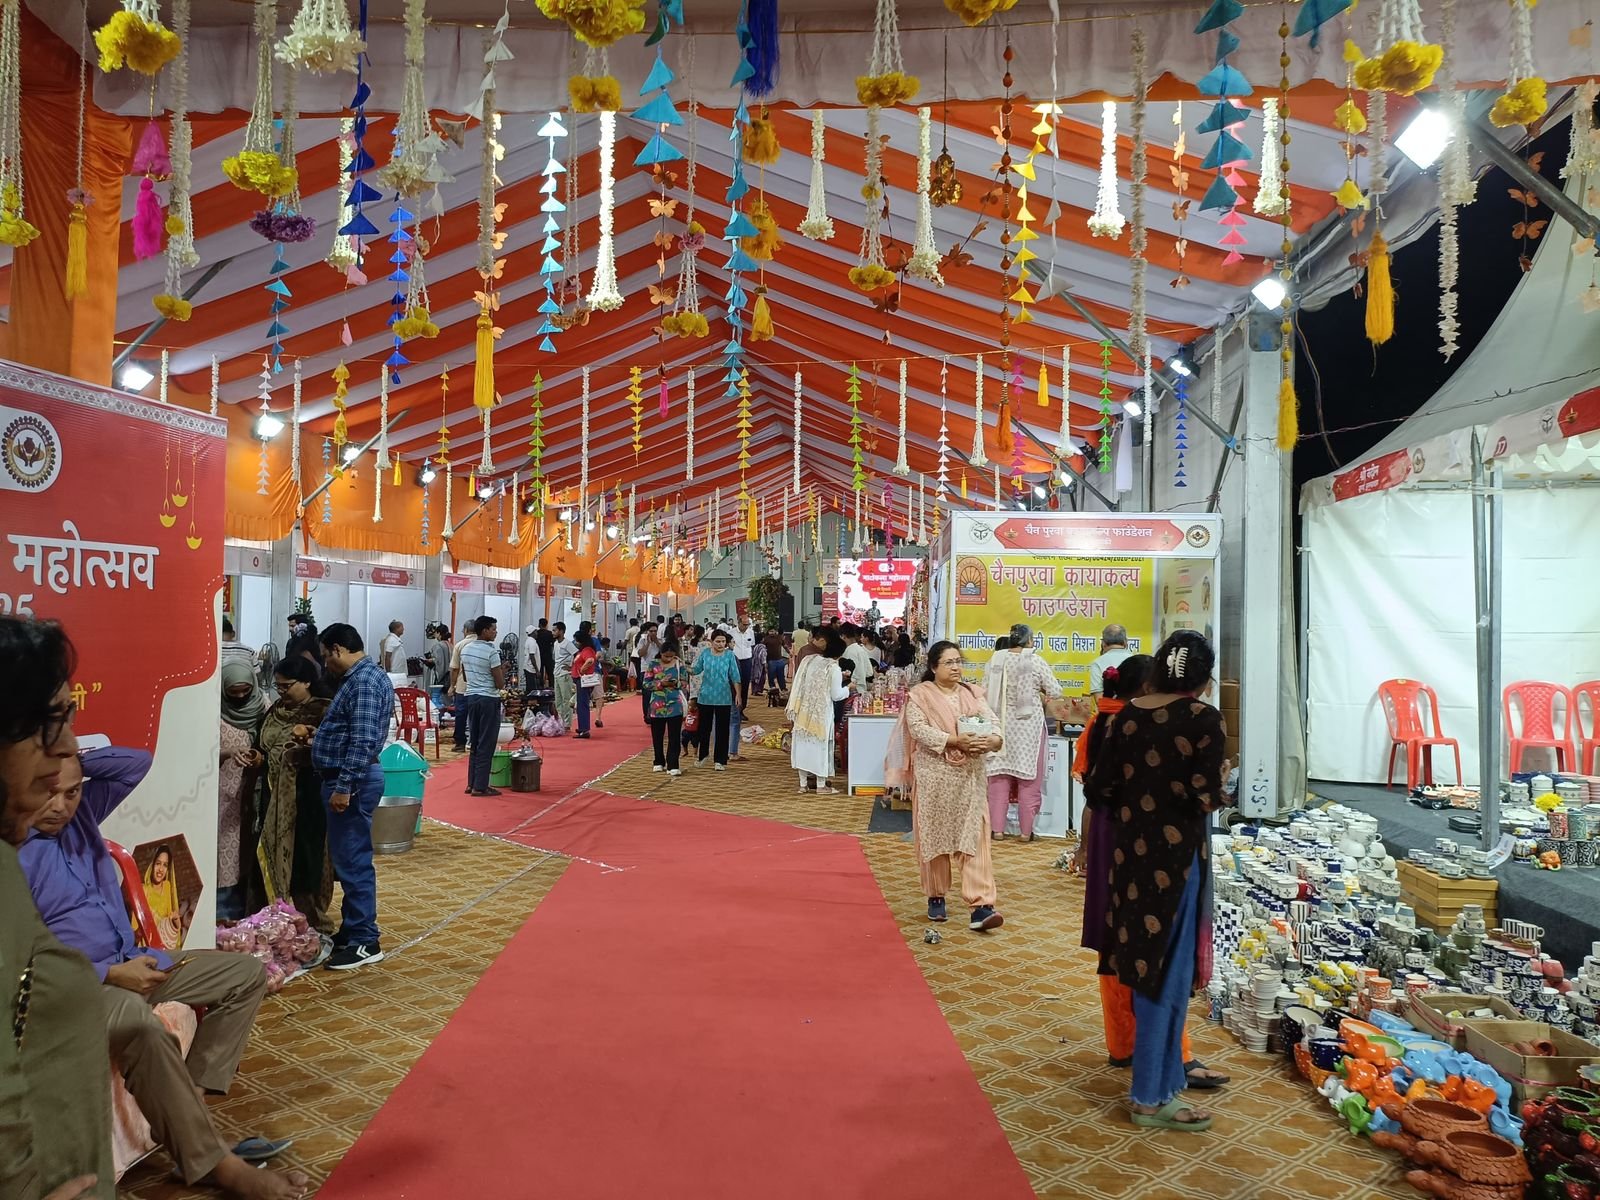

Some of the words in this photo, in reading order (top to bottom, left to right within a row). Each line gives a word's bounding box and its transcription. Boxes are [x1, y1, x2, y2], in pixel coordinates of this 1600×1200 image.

[7, 519, 159, 594] महोत्सव
[990, 558, 1056, 592] चैनपुरवा
[1064, 567, 1141, 588] कायाकल्प
[1022, 591, 1107, 618] फाउण्डेशन
[958, 630, 996, 649] सामाजिक
[1049, 636, 1068, 651] पहल
[1072, 632, 1095, 652] मिशन
